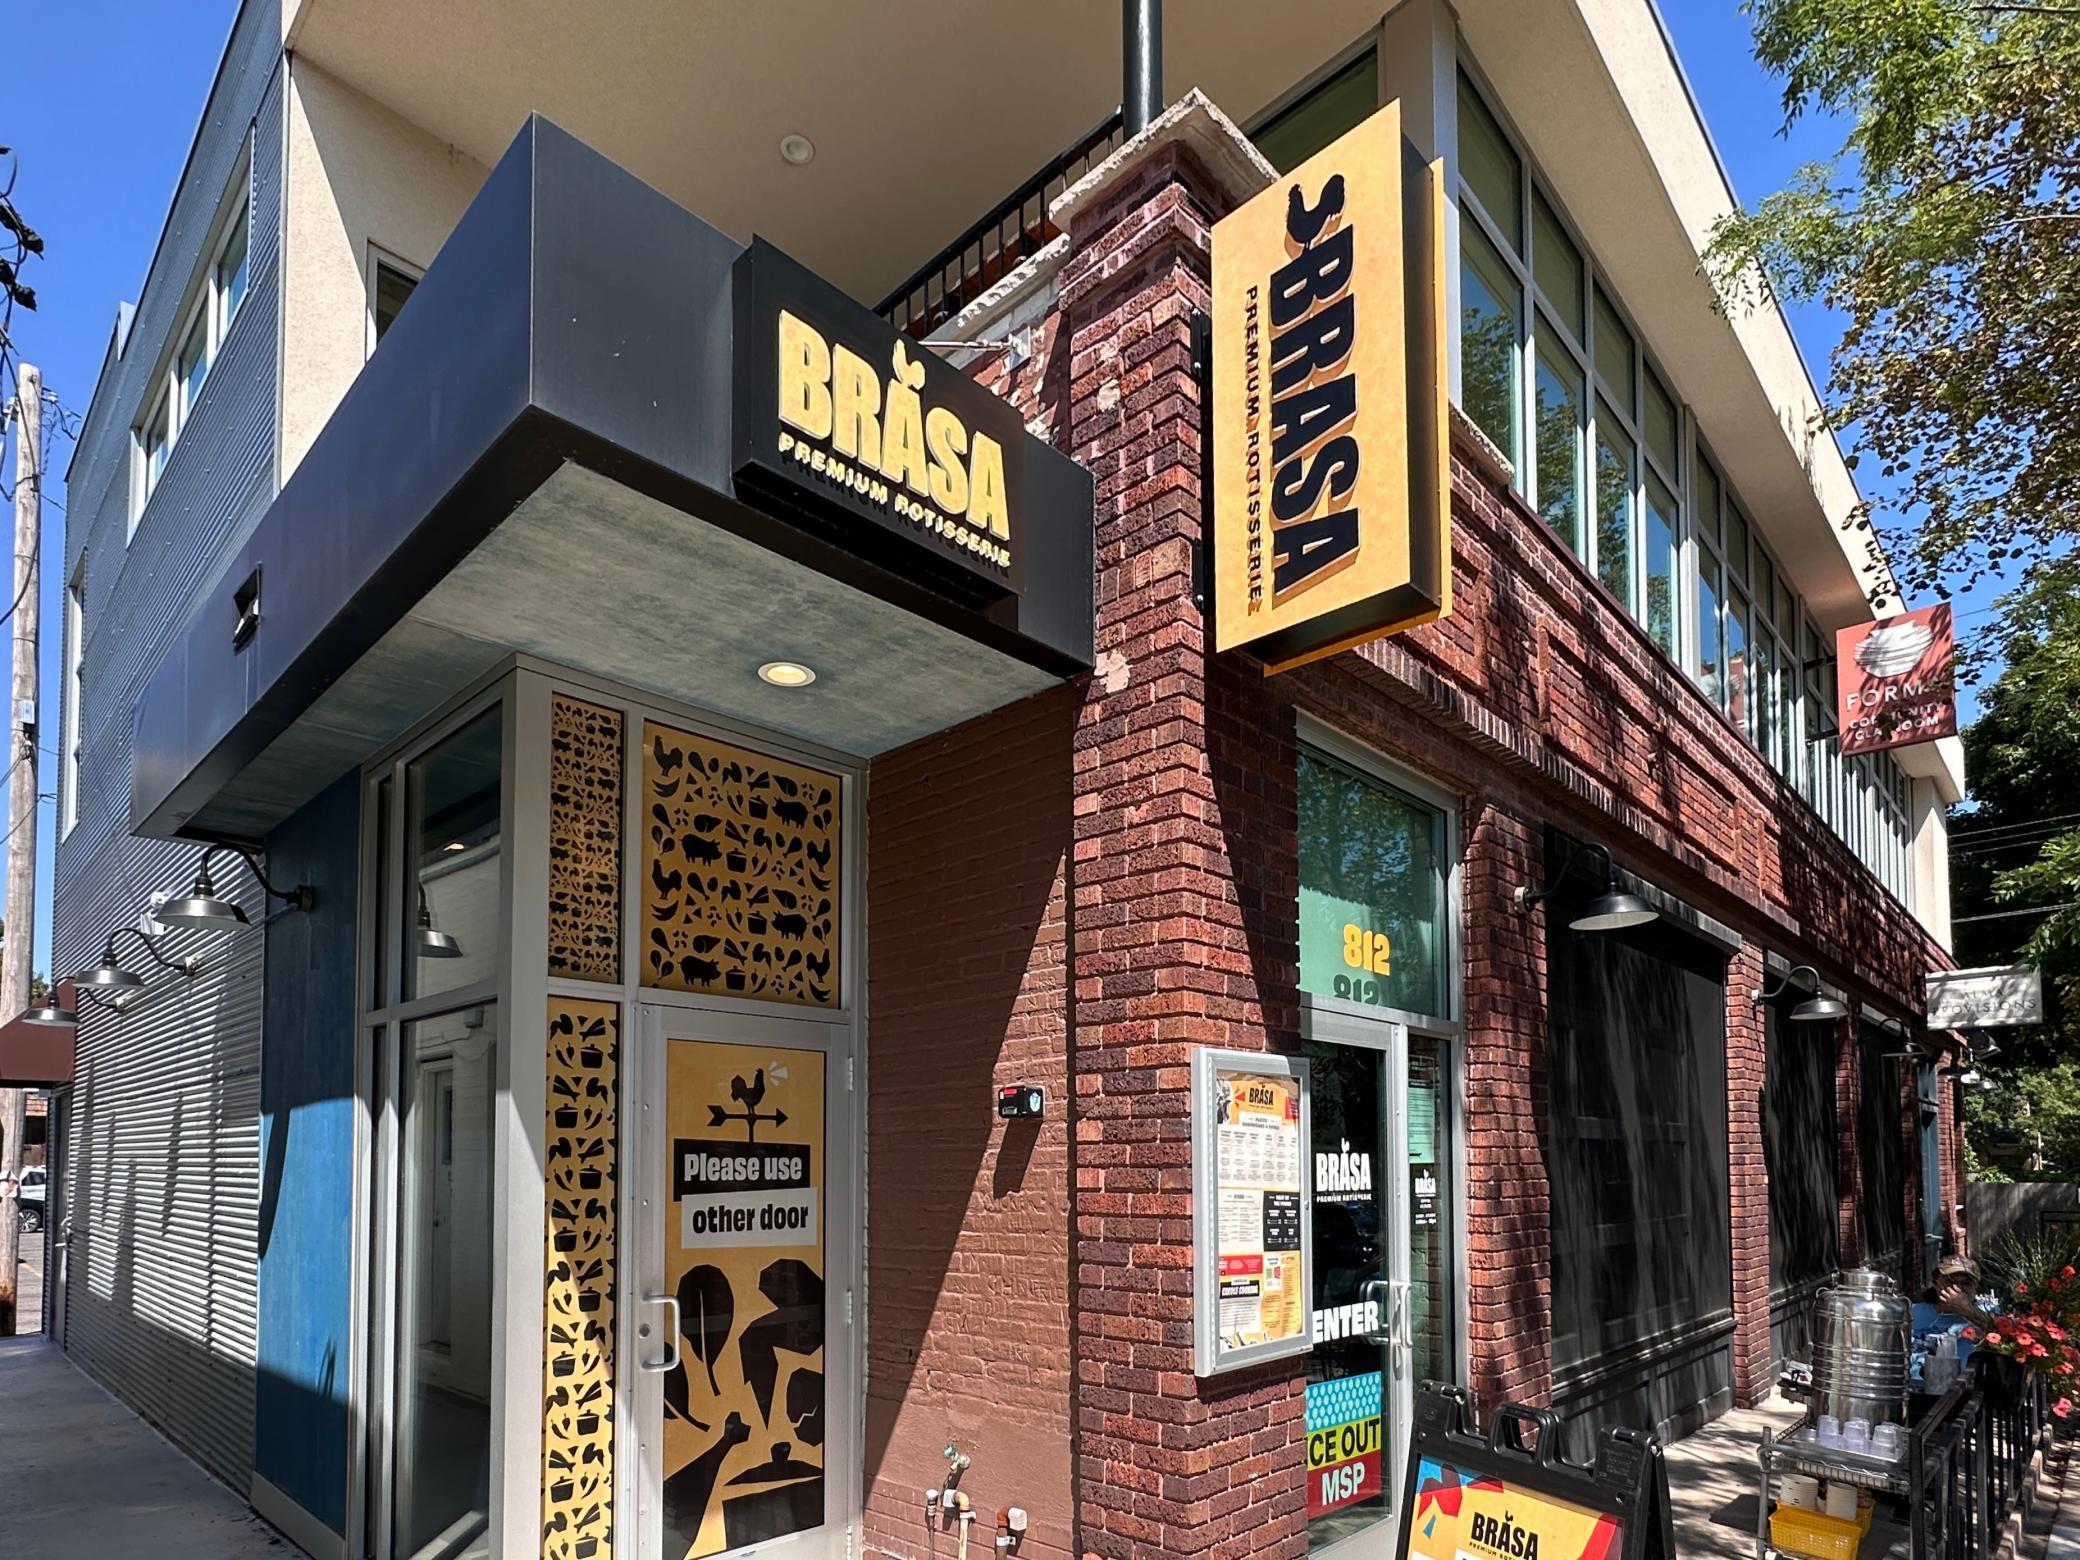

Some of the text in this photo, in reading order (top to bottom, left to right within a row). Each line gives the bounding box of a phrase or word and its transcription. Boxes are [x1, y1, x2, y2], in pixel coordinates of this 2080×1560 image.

[1270, 223, 1359, 597] BRASA
[1246, 285, 1262, 601] PREMIUM ROTISSERIE
[778, 432, 1010, 568] PREMIUM ROTISSERIE
[1343, 923, 1390, 976] 812
[684, 1152, 802, 1181] Please use
[692, 1203, 808, 1234] other door
[1312, 1300, 1379, 1344] ENTER
[1306, 1418, 1380, 1467] CE OUT
[1322, 1461, 1365, 1506] MSP
[1469, 1541, 1497, 1557] PREMIUM
